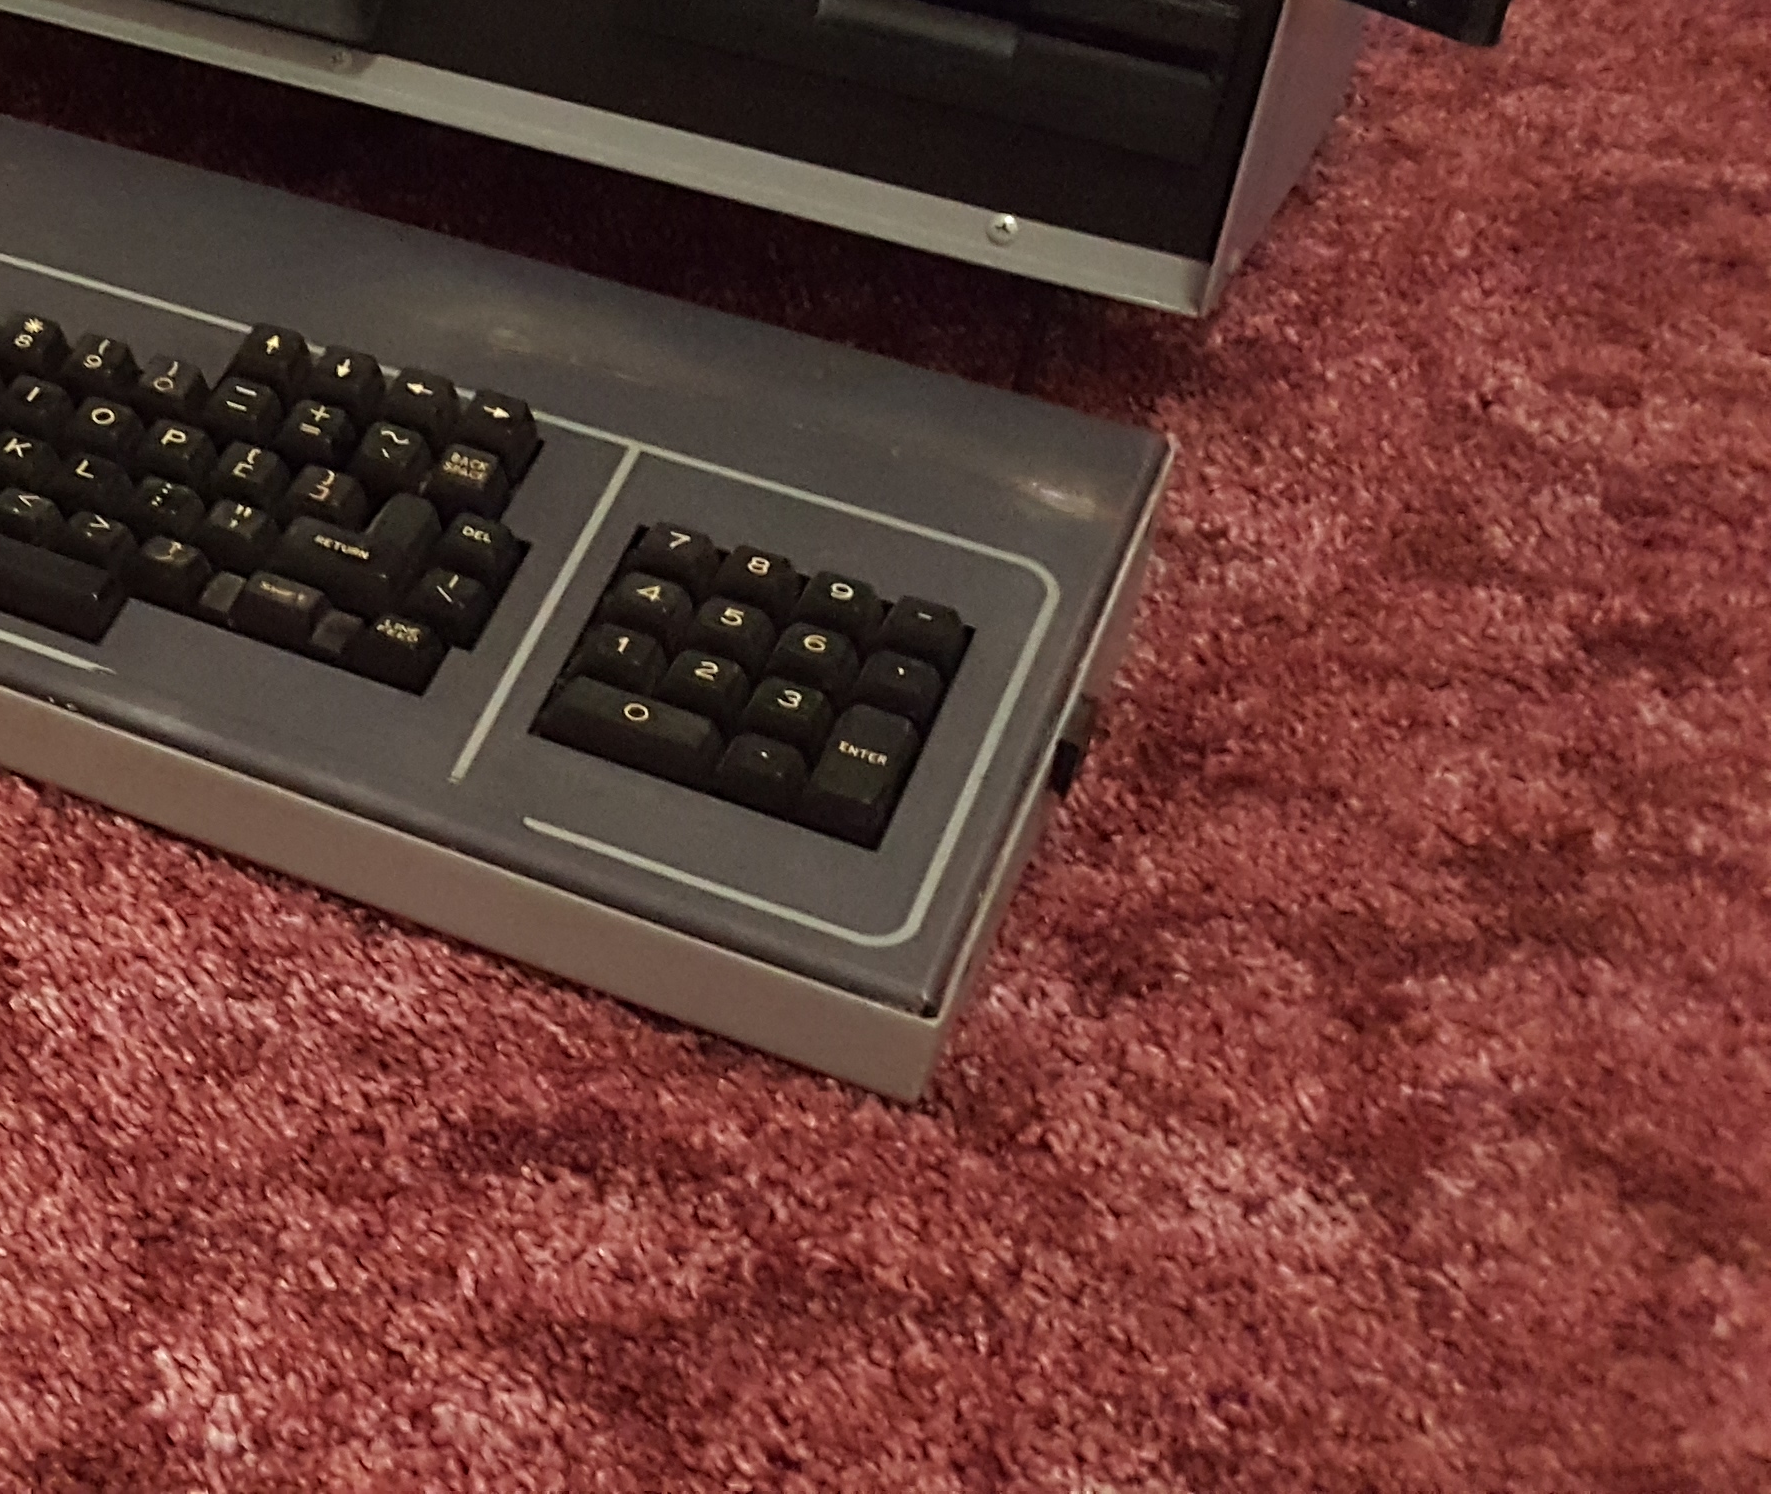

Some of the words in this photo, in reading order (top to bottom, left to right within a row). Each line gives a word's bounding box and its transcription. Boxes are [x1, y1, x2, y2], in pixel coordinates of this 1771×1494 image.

[15, 334, 32, 347] 8
[84, 355, 102, 367] 9
[92, 408, 115, 424] O
[161, 429, 186, 444] P
[4, 438, 31, 457] K
[76, 460, 93, 478] L
[463, 526, 491, 542] DEL
[670, 532, 690, 548] 7
[315, 535, 369, 559] RETURN
[747, 556, 770, 576] 8
[637, 586, 660, 601] 4
[831, 583, 853, 599] 9
[721, 608, 743, 625] 5
[618, 637, 629, 652] 1
[804, 635, 826, 651] 6
[695, 661, 718, 680] 2
[778, 690, 801, 707] 3
[839, 741, 887, 765] ENTER
